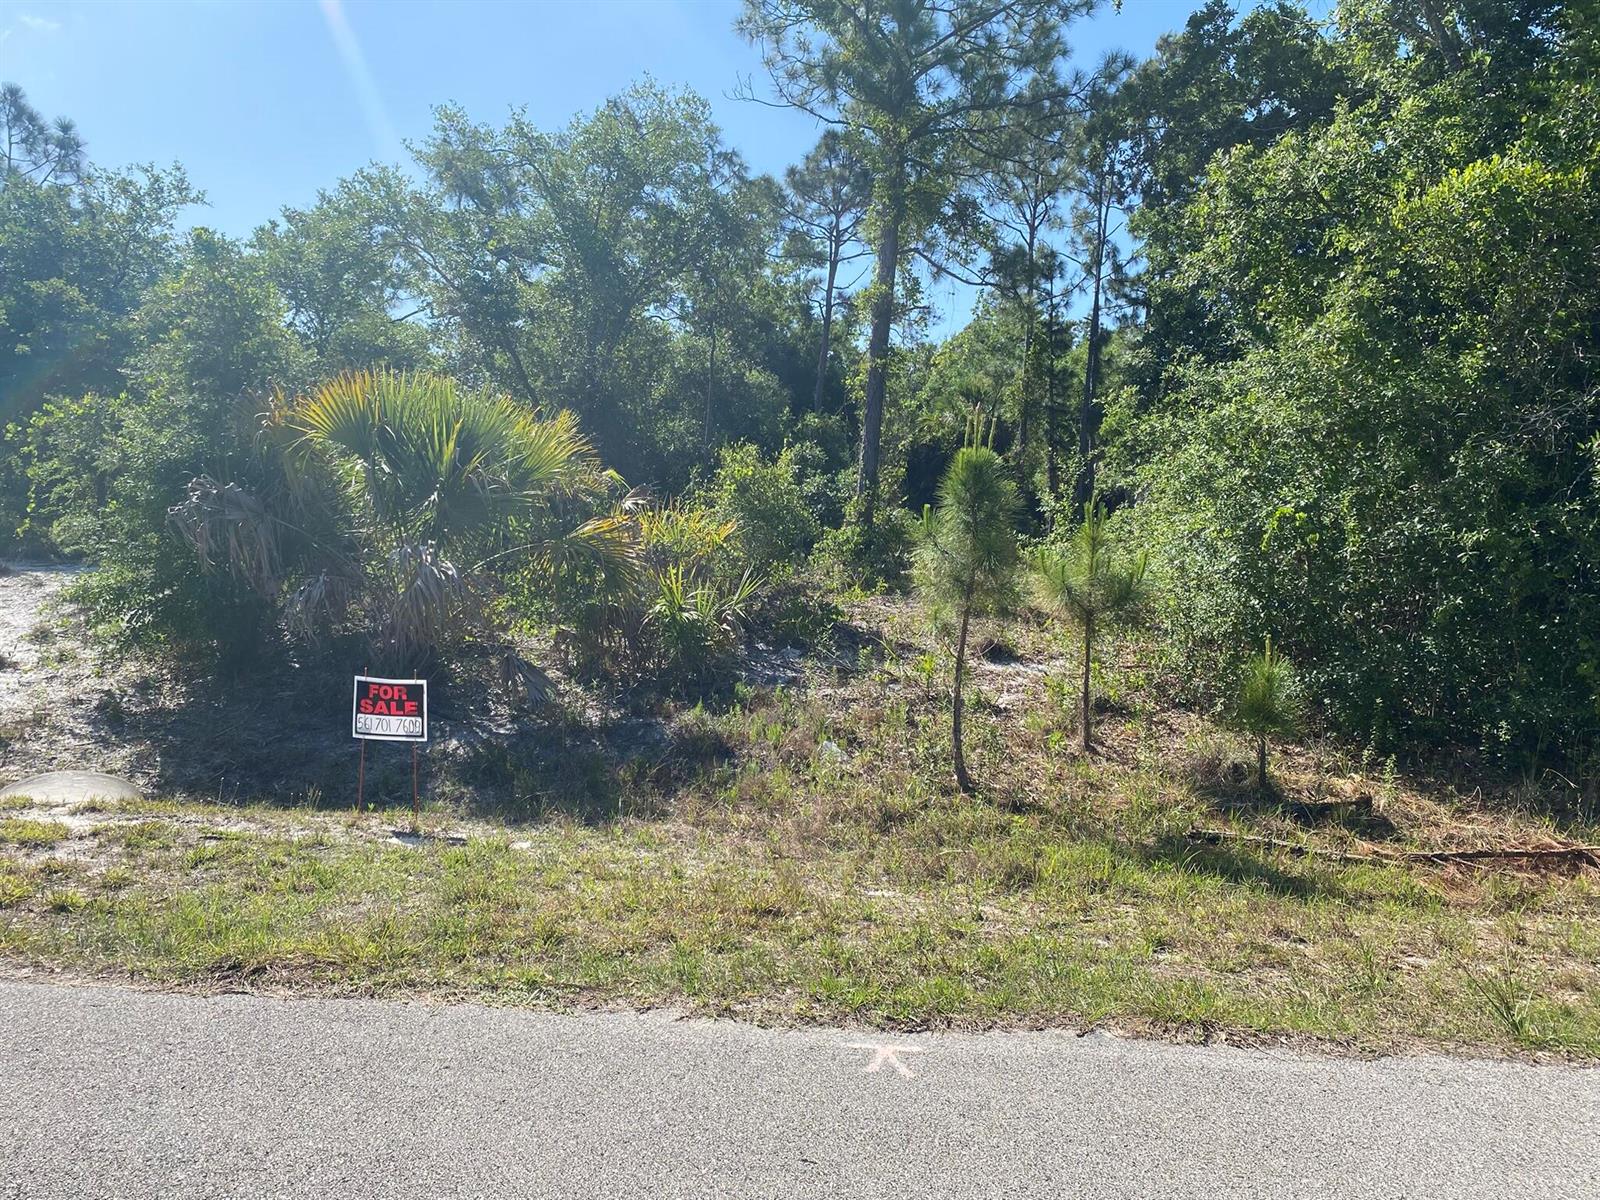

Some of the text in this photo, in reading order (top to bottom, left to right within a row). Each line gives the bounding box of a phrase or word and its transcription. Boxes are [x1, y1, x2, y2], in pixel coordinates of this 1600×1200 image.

[368, 684, 407, 700] FOR
[359, 698, 418, 715] SALE
[357, 716, 372, 731] 561
[375, 717, 391, 733] 701
